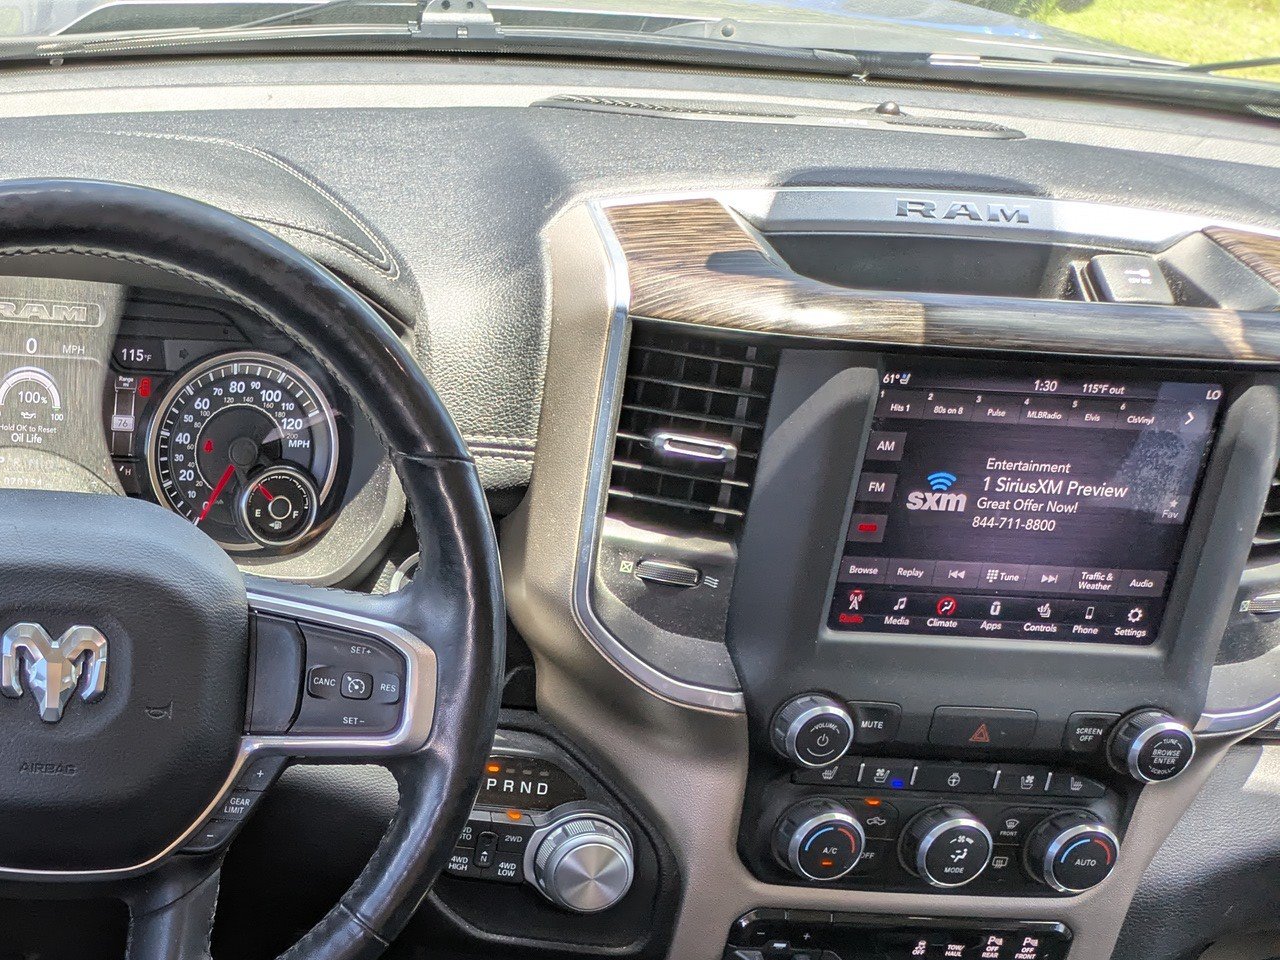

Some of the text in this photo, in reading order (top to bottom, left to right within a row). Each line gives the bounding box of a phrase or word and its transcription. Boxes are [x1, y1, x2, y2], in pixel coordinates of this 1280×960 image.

[896, 198, 1030, 224] RAM
[26, 338, 85, 354] 0 MPH
[230, 382, 245, 393] 80
[1034, 380, 1057, 391] 1:30
[213, 388, 223, 396] 70
[1109, 386, 1125, 395] out
[1205, 390, 1222, 400] LO
[18, 391, 47, 404] 100%
[260, 390, 281, 402] 100
[194, 398, 210, 409] 60
[891, 404, 904, 412] Hits
[51, 413, 64, 421] 100
[987, 409, 1006, 417] Pulse
[1027, 411, 1062, 419] MLBRadio
[1085, 414, 1100, 422] Elvis
[16, 424, 27, 432] OK
[118, 419, 128, 428] 76
[282, 419, 302, 429] 120
[11, 434, 42, 443] Oil Life
[175, 433, 190, 444] 40
[289, 440, 310, 448] MPH
[877, 441, 895, 451] AM
[174, 454, 184, 462] 30
[986, 458, 1071, 473] Entertainment
[179, 470, 194, 481] 20
[868, 482, 885, 492] FM
[983, 477, 1128, 498] 1 SiriusXM Preview
[906, 491, 967, 512] sxm
[977, 498, 1078, 514] Great Offer Now!
[255, 509, 261, 517] E
[1162, 510, 1179, 519] Fav
[972, 517, 1056, 532] 844-711-8800
[849, 566, 878, 575] Browse
[897, 568, 924, 578] Replay
[1000, 572, 1019, 582] Tune
[1081, 572, 1113, 581] Traffic &
[1078, 582, 1111, 590] Weather
[1130, 579, 1154, 588] Audio
[884, 616, 910, 625] Media
[927, 618, 957, 628] Climate
[980, 621, 1002, 630] Apps
[1024, 623, 1057, 633] Controls
[1072, 625, 1098, 635] Phone
[1114, 628, 1146, 638] Settings
[314, 677, 335, 686] CANC
[381, 684, 396, 693] RES
[861, 721, 883, 729] MUTE
[20, 762, 77, 775] AIRBAG
[487, 778, 548, 795] P R N D
[230, 797, 250, 806] GEAR
[224, 806, 244, 814] LIMIT
[822, 847, 838, 855] A/C
[448, 863, 467, 871] HIGH
[1074, 859, 1096, 867] AUTO
